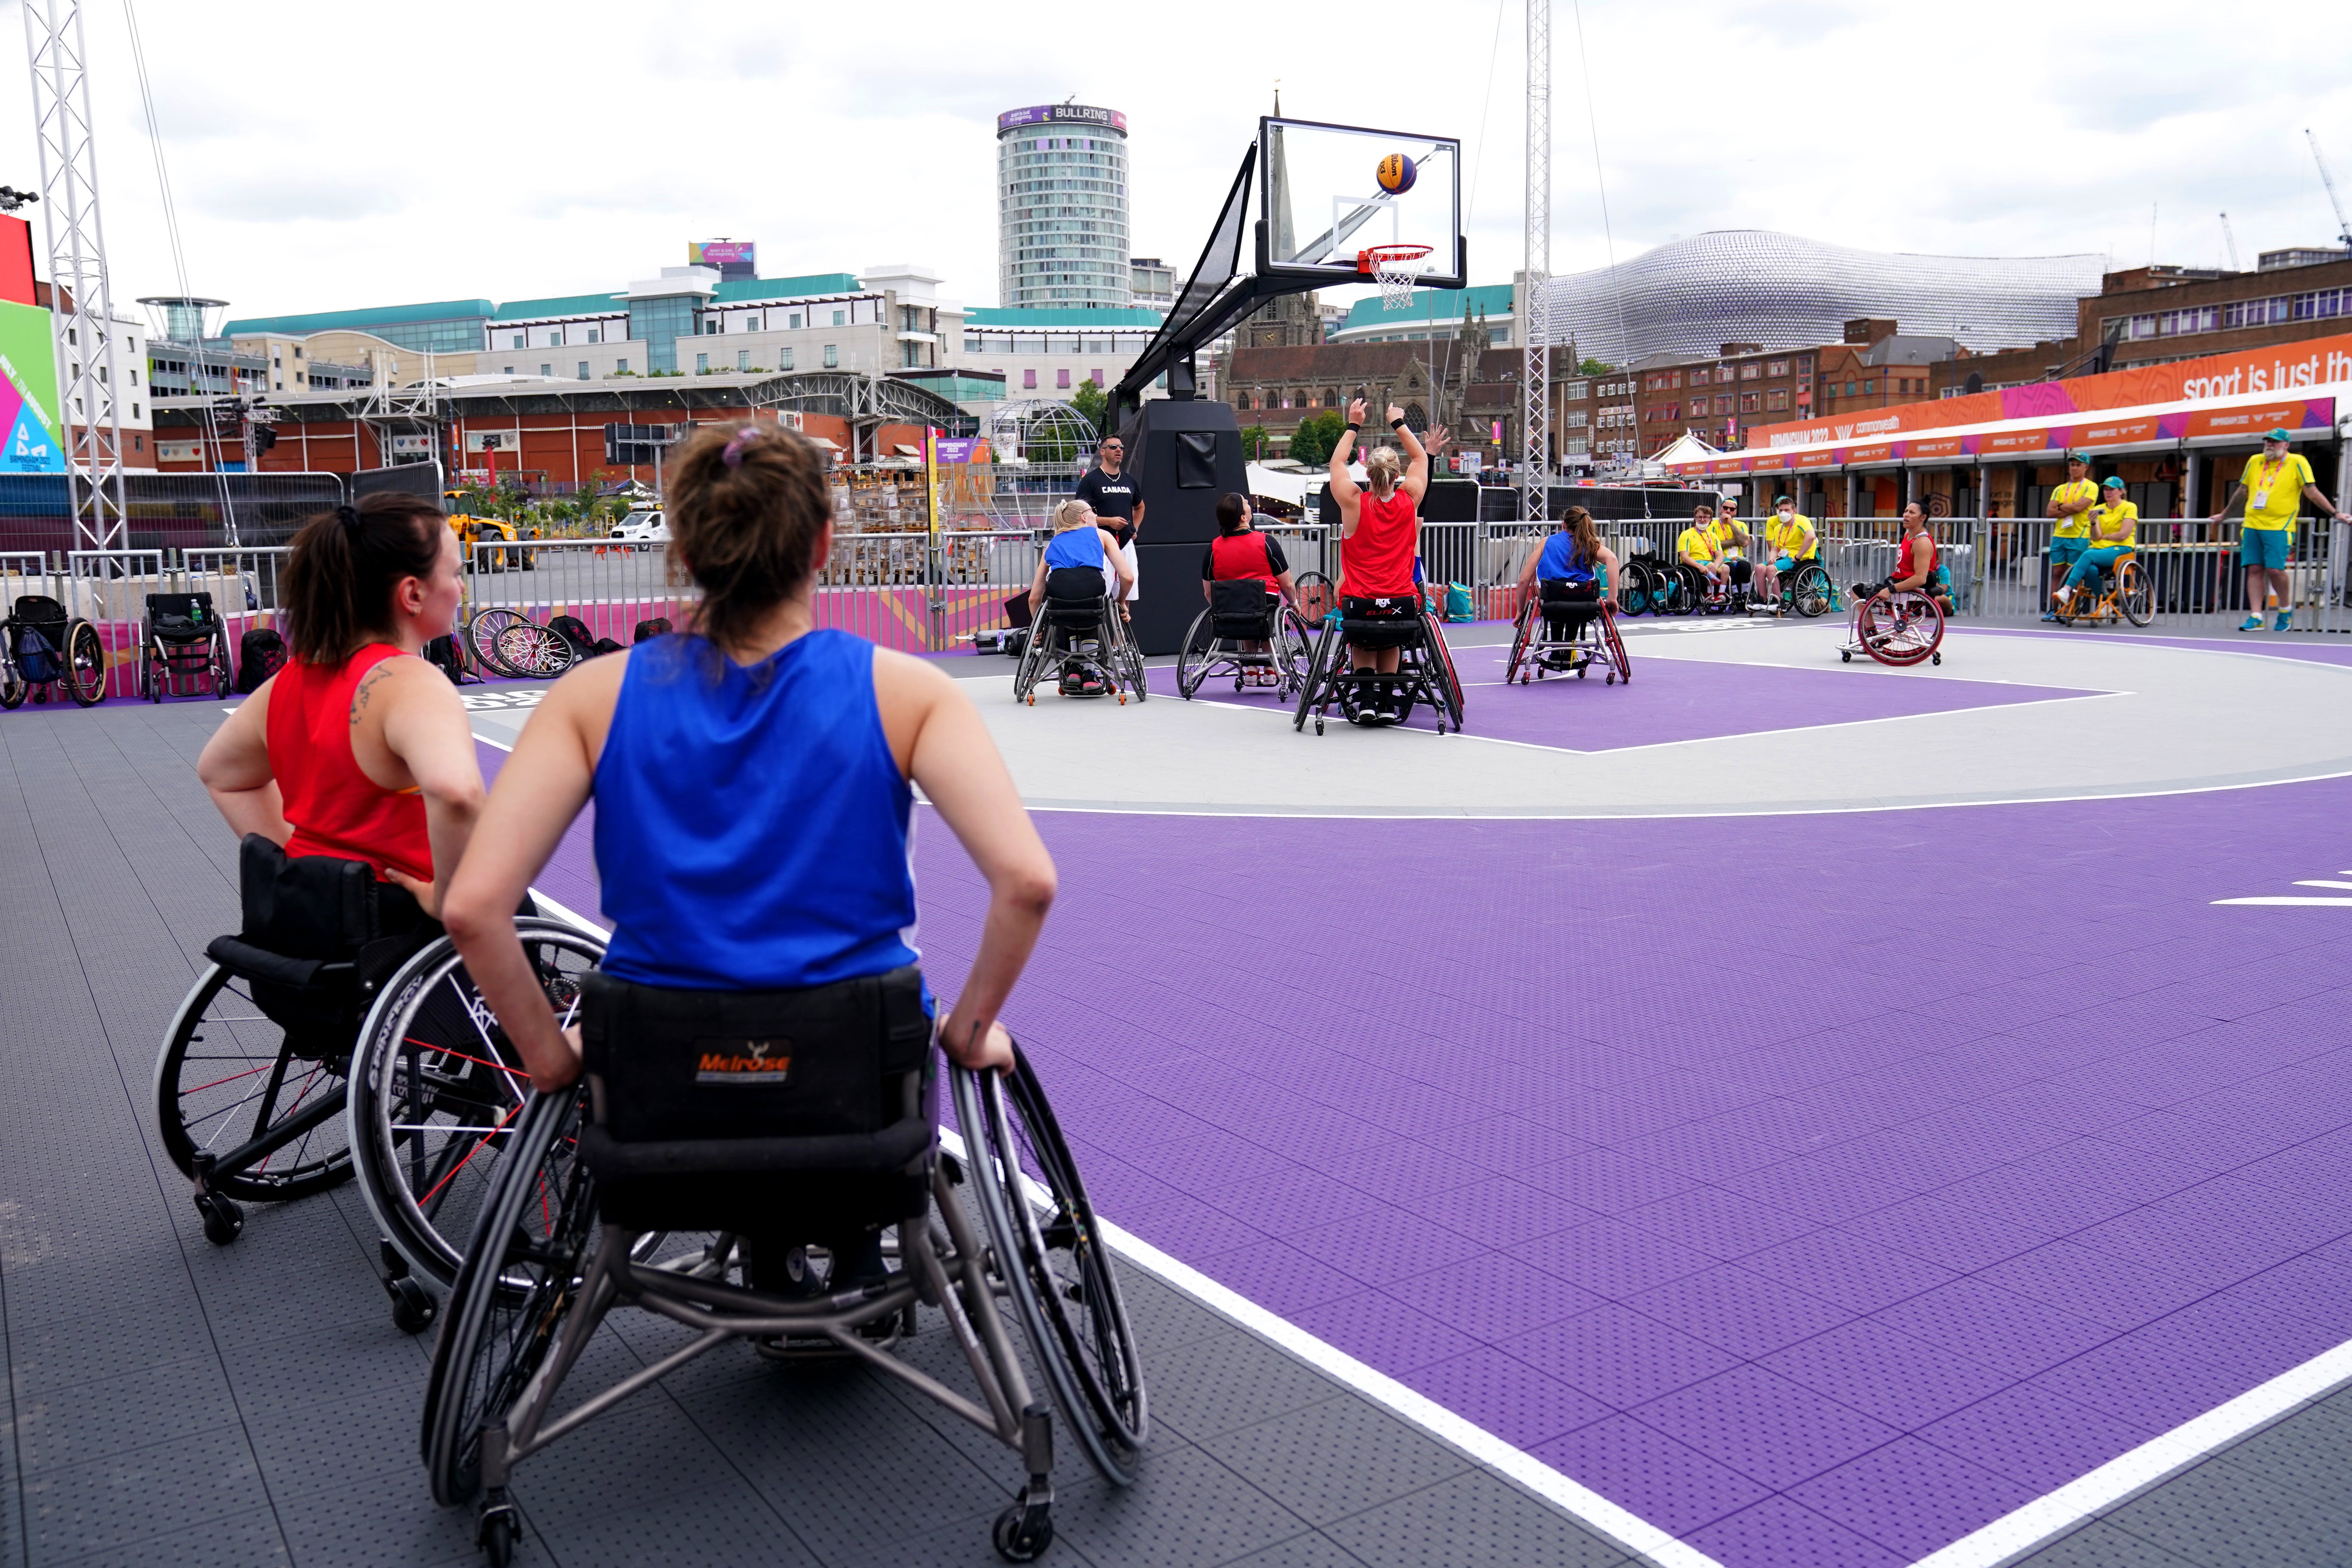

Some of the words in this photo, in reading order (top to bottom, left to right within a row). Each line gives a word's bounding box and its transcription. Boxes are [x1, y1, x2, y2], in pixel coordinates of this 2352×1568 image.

[1055, 108, 1108, 120] BULLRING
[2183, 366, 2242, 399] sport
[2248, 364, 2267, 393] is
[2273, 354, 2320, 390] just
[24, 390, 52, 430] AUGUST
[1856, 415, 1900, 433] commonwealth
[1770, 430, 1811, 447] BIRMINGHAM
[1811, 427, 1829, 443] 2022
[1375, 598, 1391, 608] RGK
[699, 1052, 790, 1072] Melrose
